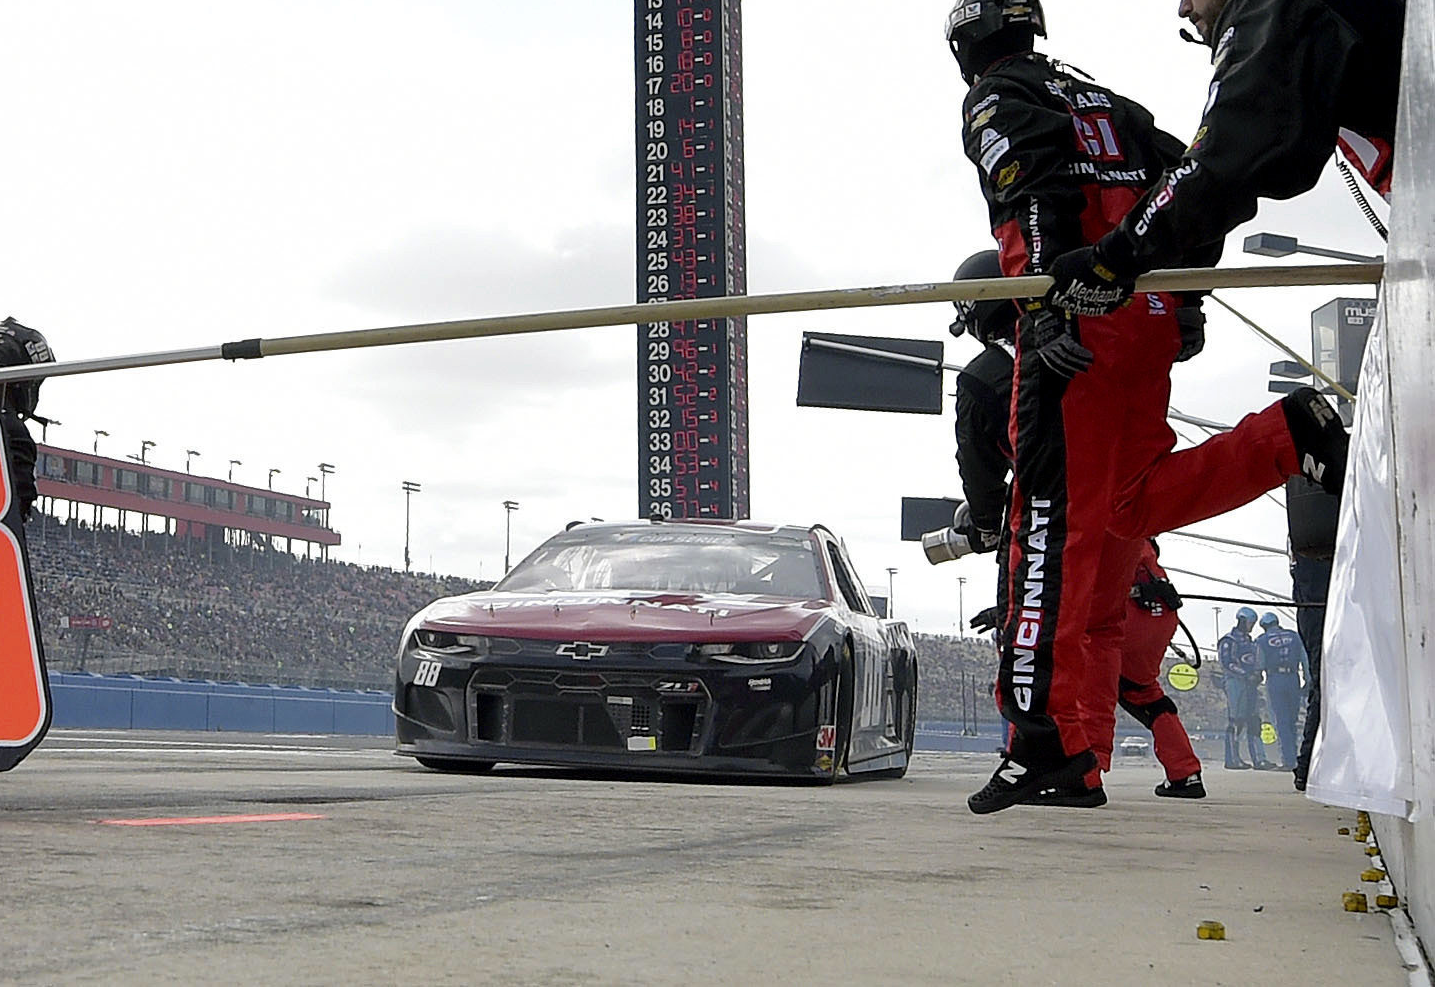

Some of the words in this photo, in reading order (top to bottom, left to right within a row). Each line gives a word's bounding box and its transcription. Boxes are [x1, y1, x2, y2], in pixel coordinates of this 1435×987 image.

[645, 12, 664, 31] 14
[645, 33, 664, 52] 15
[645, 55, 664, 74] 16
[645, 76, 663, 95] 17
[645, 98, 665, 117] 18
[646, 120, 665, 139] 19
[646, 141, 668, 161] 20
[646, 164, 664, 183] 21
[646, 186, 668, 205] 22
[646, 208, 668, 227] 23
[647, 230, 668, 249] 24
[647, 252, 668, 271] 25
[647, 274, 669, 294] 26
[1065, 278, 1124, 304] Mechanix
[648, 320, 670, 338] 28
[648, 341, 670, 361] 29
[648, 363, 671, 383] 30
[648, 386, 667, 406] 31
[649, 409, 671, 429] 32
[649, 432, 671, 452] 33
[649, 455, 672, 475] 34
[649, 478, 672, 498] 35
[650, 501, 673, 520] 36
[1013, 495, 1052, 712] CINCINNATI
[412, 660, 442, 687] 88
[817, 727, 836, 750] 3M
